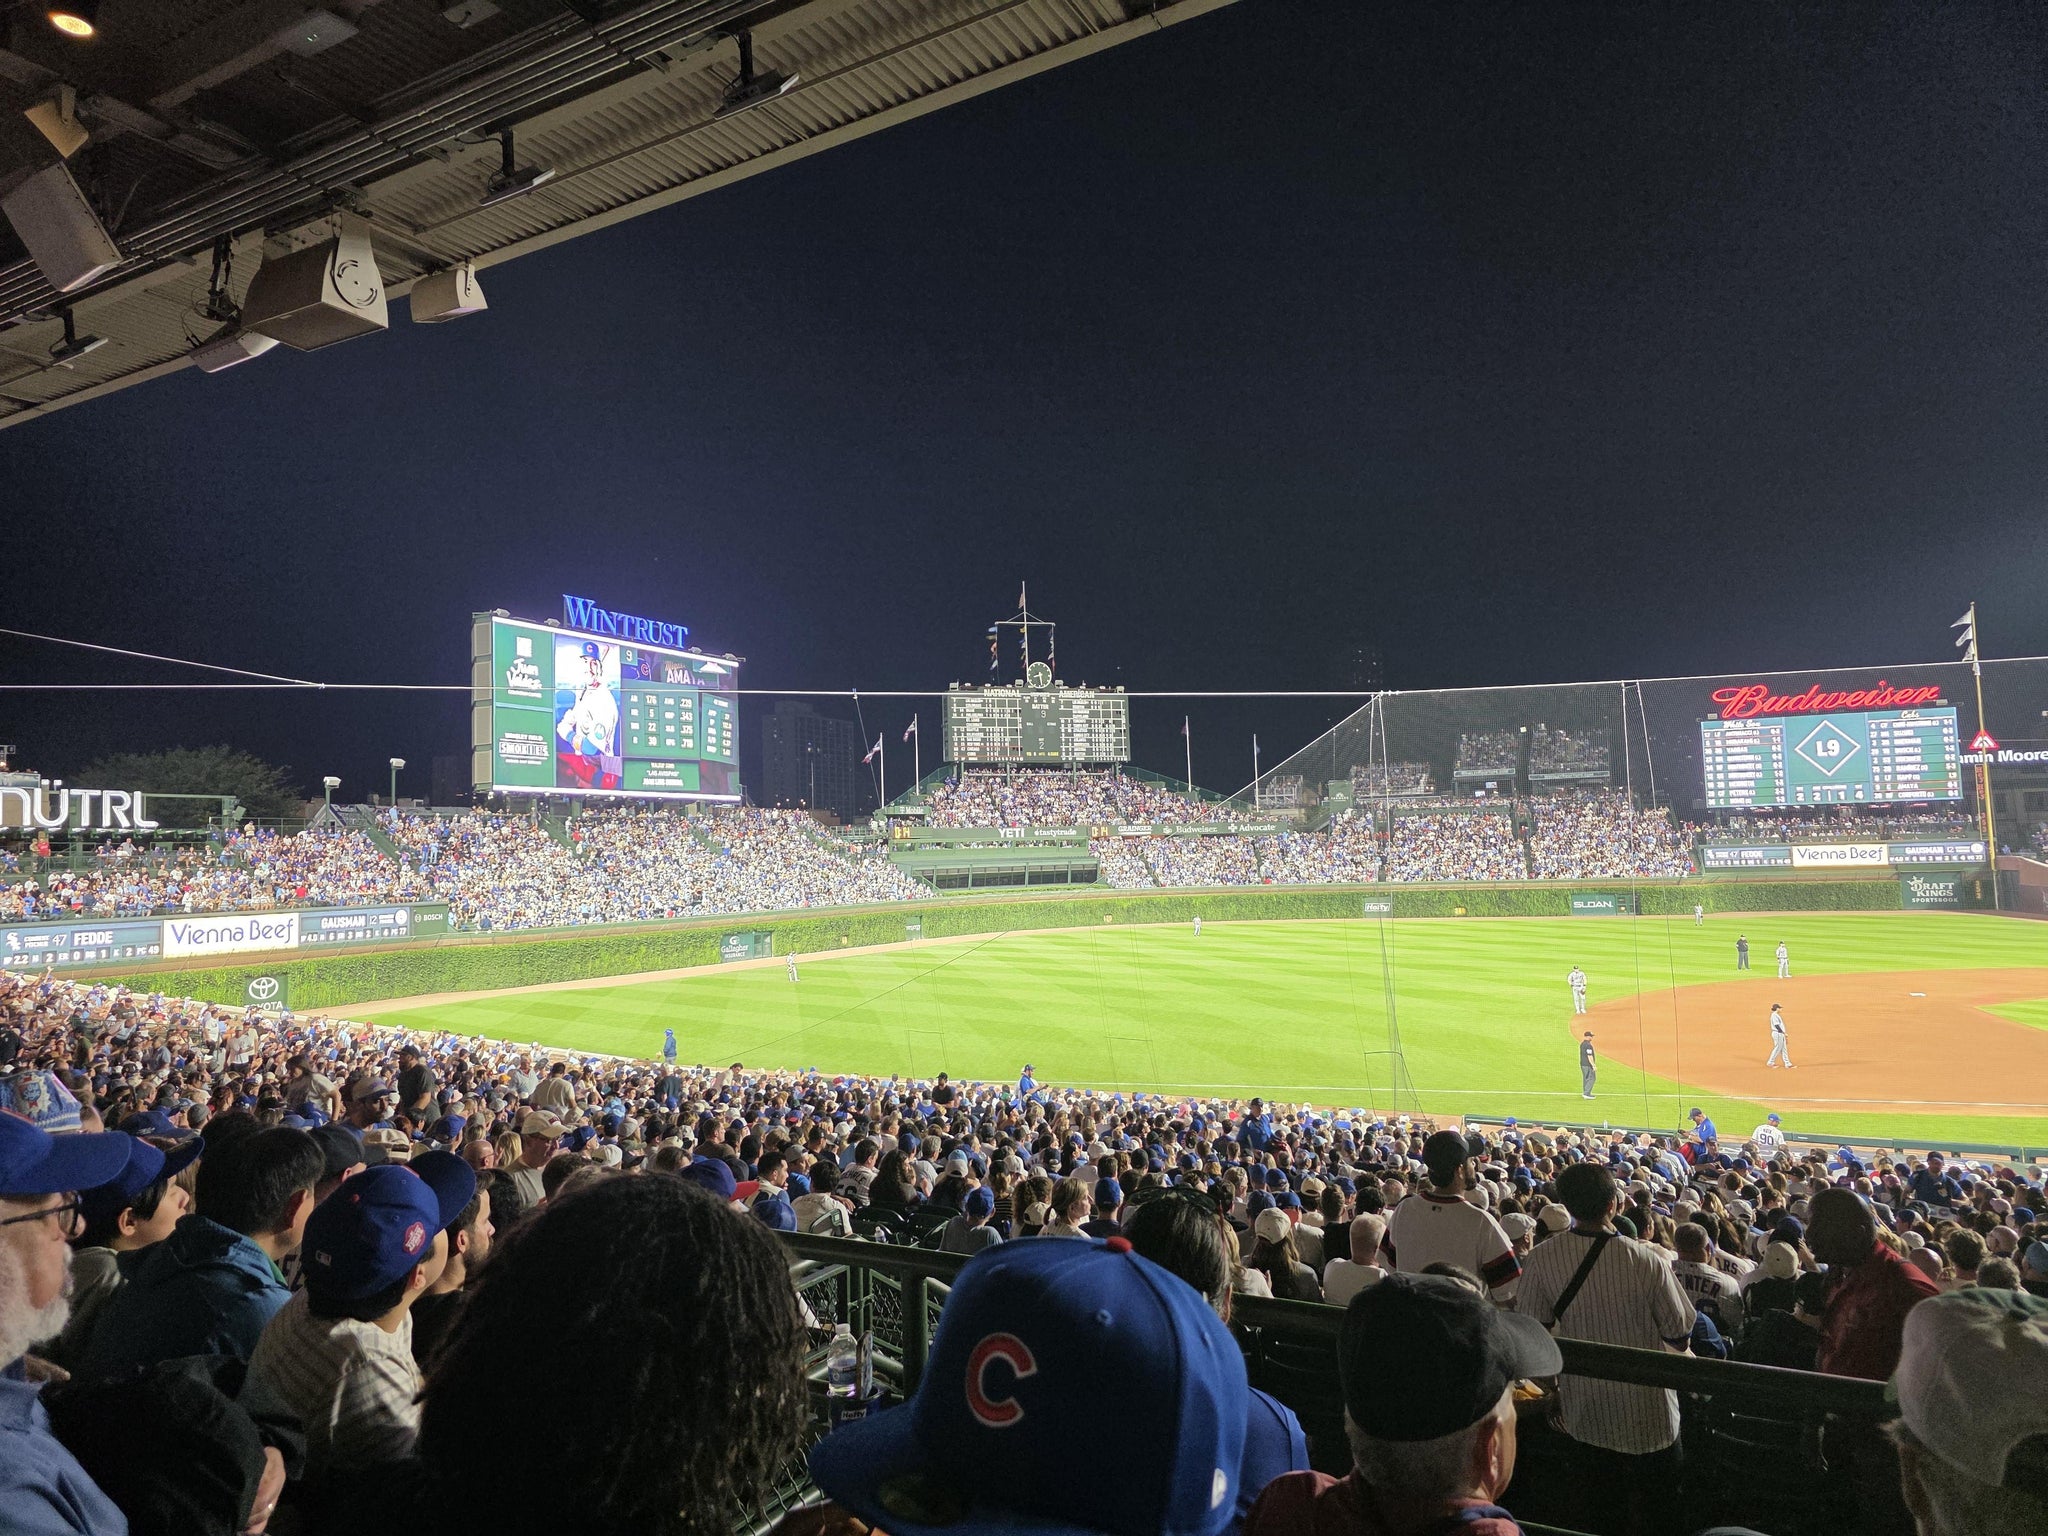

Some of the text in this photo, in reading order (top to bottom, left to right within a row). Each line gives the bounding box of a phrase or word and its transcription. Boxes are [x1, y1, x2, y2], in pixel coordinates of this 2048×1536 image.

[562, 594, 689, 648] WINTRUST
[984, 688, 1020, 697] NATIONAL
[1059, 690, 1094, 698] AMERICAN
[1711, 680, 1940, 719] Budweiser
[1901, 710, 1920, 719] Cubs
[1723, 720, 1744, 729] White
[1816, 739, 1840, 757] L9
[1998, 749, 2048, 762] Moore
[1796, 790, 1864, 802] 2 2 1 4
[998, 827, 1025, 837] YETI
[1176, 825, 1218, 833] Budweiser
[1239, 824, 1277, 832] Advocate
[1740, 850, 1763, 858] FEDDE
[1797, 846, 1883, 862] Vienna Beef
[1905, 846, 1944, 854] GAUSMAN
[1910, 881, 1955, 892] DRAFT
[1916, 889, 1954, 897] KINGS
[321, 915, 366, 929] GAUSMAN
[370, 915, 377, 925] 12
[423, 913, 443, 921] BOSCH
[171, 918, 294, 945] Vienna Beef
[366, 930, 371, 938] 2
[383, 928, 389, 937] 4
[52, 930, 114, 947] 47 FEDDE
[721, 943, 749, 953] Gallagher
[46, 953, 54, 963] 2
[73, 951, 80, 960] 0
[101, 949, 107, 959] 1
[126, 947, 133, 957] 2
[148, 945, 160, 955] 49
[1760, 1133, 1774, 1146] 90
[966, 1332, 1038, 1427] C
